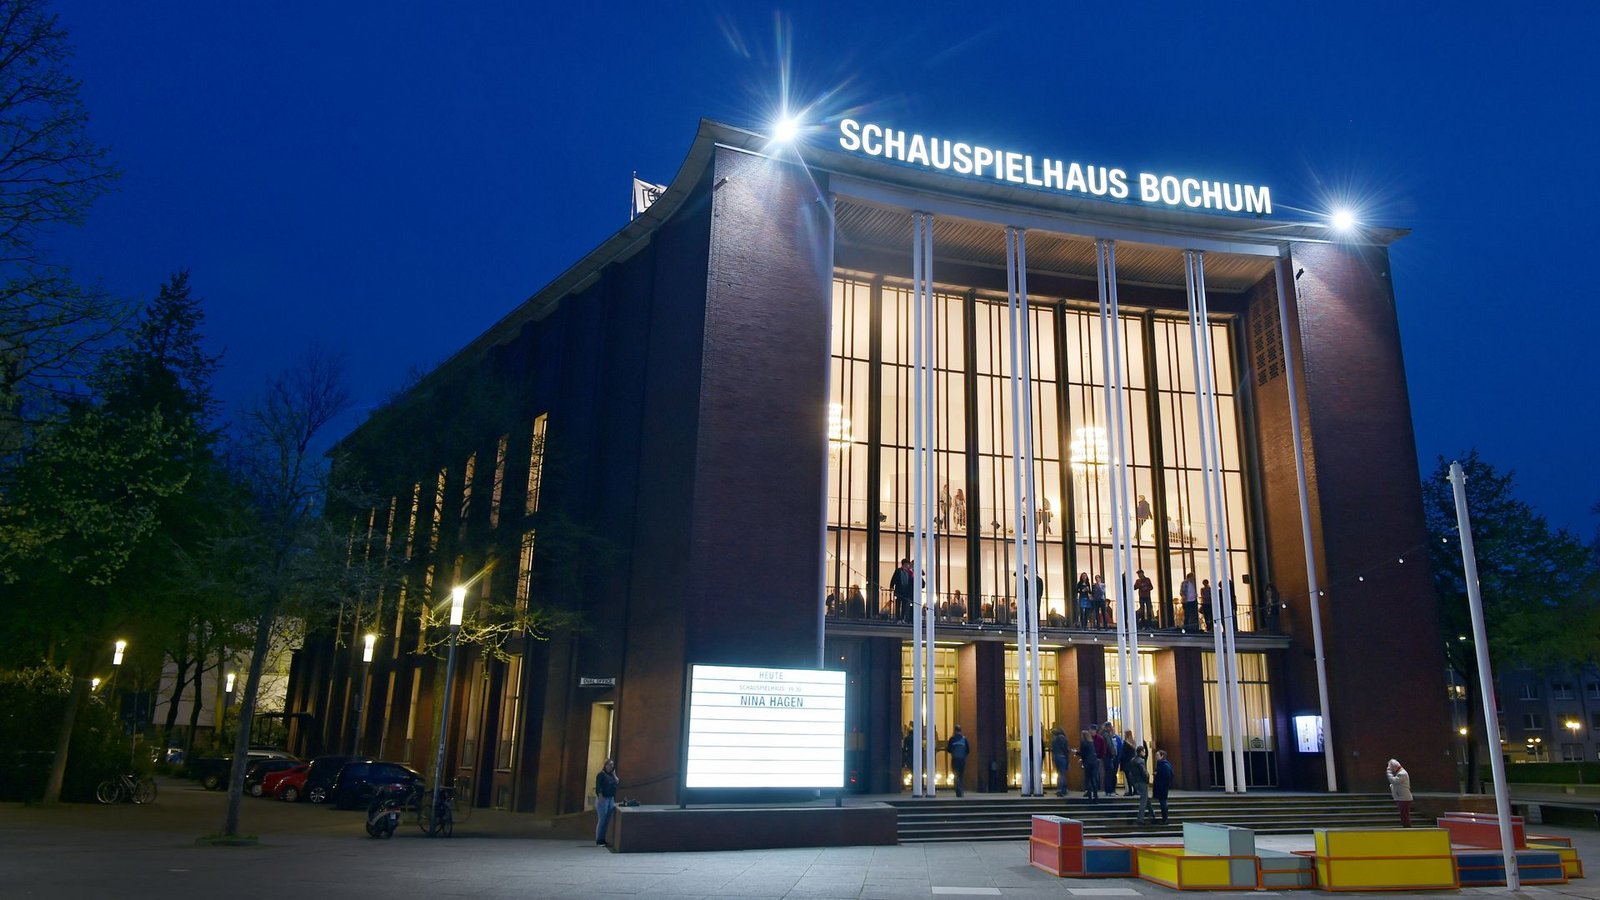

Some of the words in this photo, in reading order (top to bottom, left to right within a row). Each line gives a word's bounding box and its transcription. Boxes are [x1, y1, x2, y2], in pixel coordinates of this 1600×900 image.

[839, 119, 1129, 199] SCHAUSPIELHAUS
[1139, 172, 1272, 215] BOCHUM
[759, 671, 784, 680] HEUTE
[740, 695, 766, 706] NINA
[769, 696, 804, 707] HAGEN
